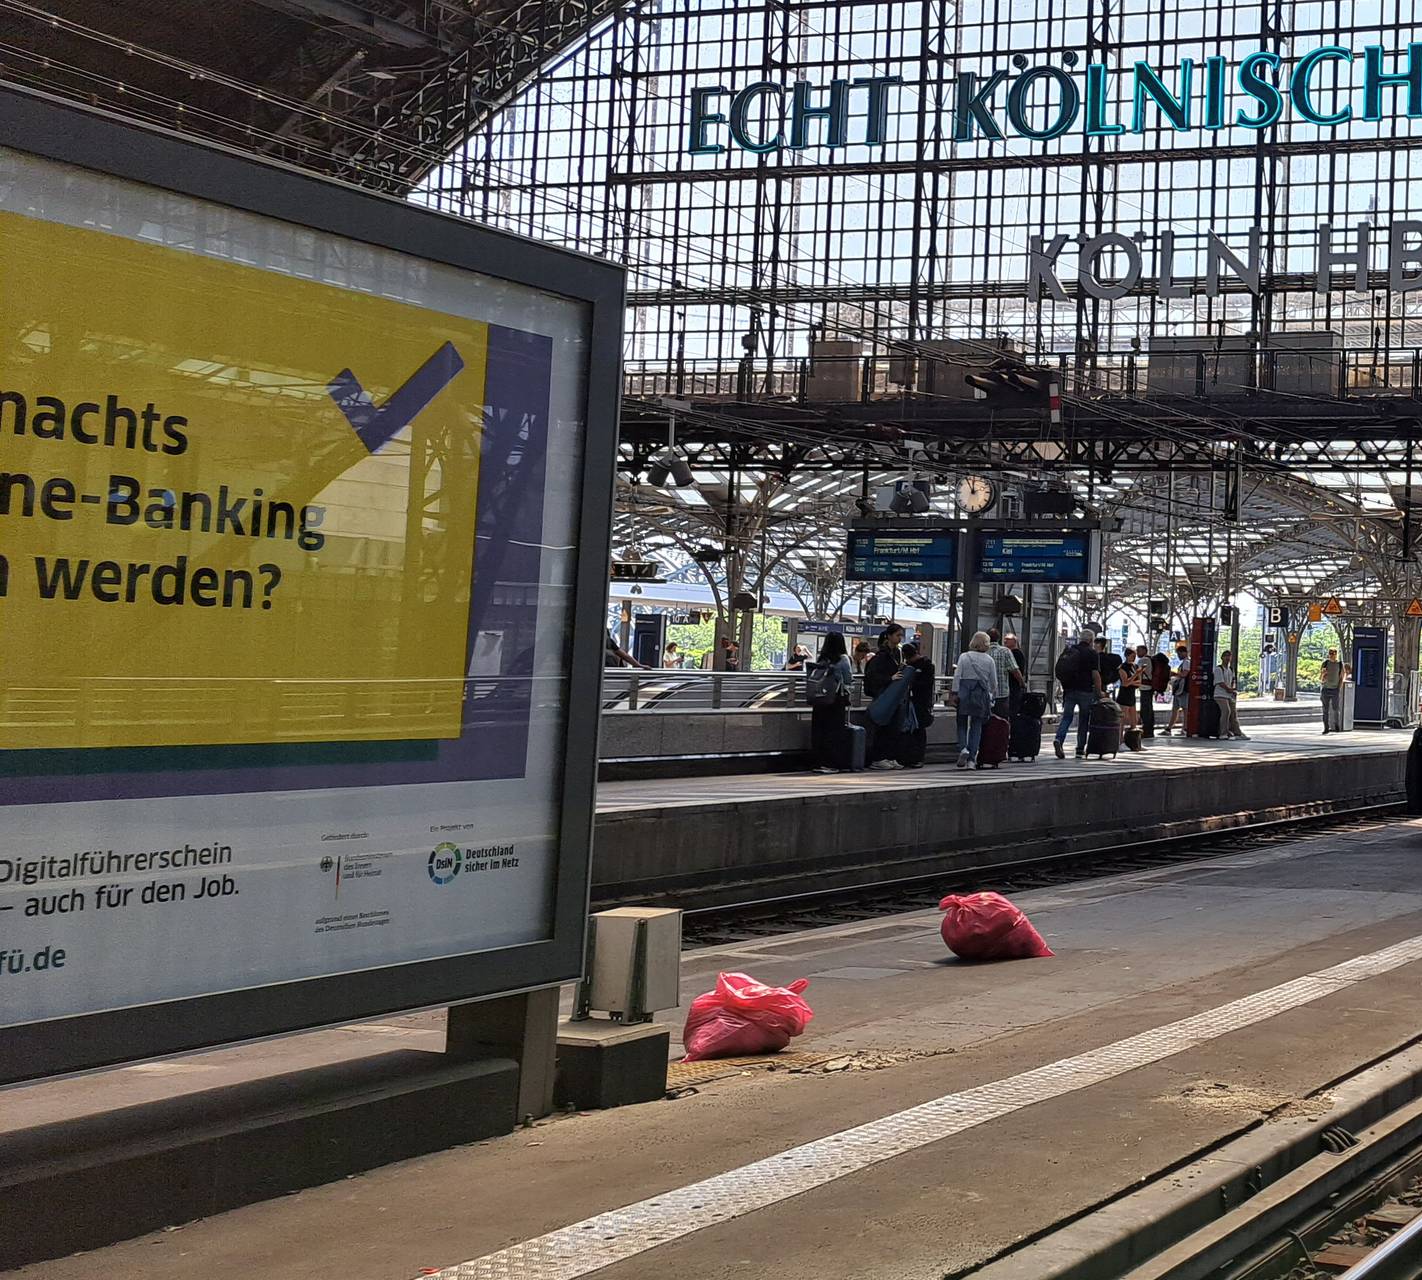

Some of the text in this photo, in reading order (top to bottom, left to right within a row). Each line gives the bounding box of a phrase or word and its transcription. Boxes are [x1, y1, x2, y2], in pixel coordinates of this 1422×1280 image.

[688, 75, 904, 155] ECHT
[1028, 225, 1262, 302] KÖLN
[0, 472, 327, 551] ne-Banking
[34, 555, 282, 610] werden?
[1271, 607, 1282, 623] B
[0, 842, 233, 885] Digitalführerschein
[464, 857, 520, 873] sicher im Netz
[466, 844, 514, 860] Deutschland
[24, 888, 84, 917] auch
[95, 884, 134, 909] für
[141, 881, 185, 905] den
[193, 874, 240, 899] Job.
